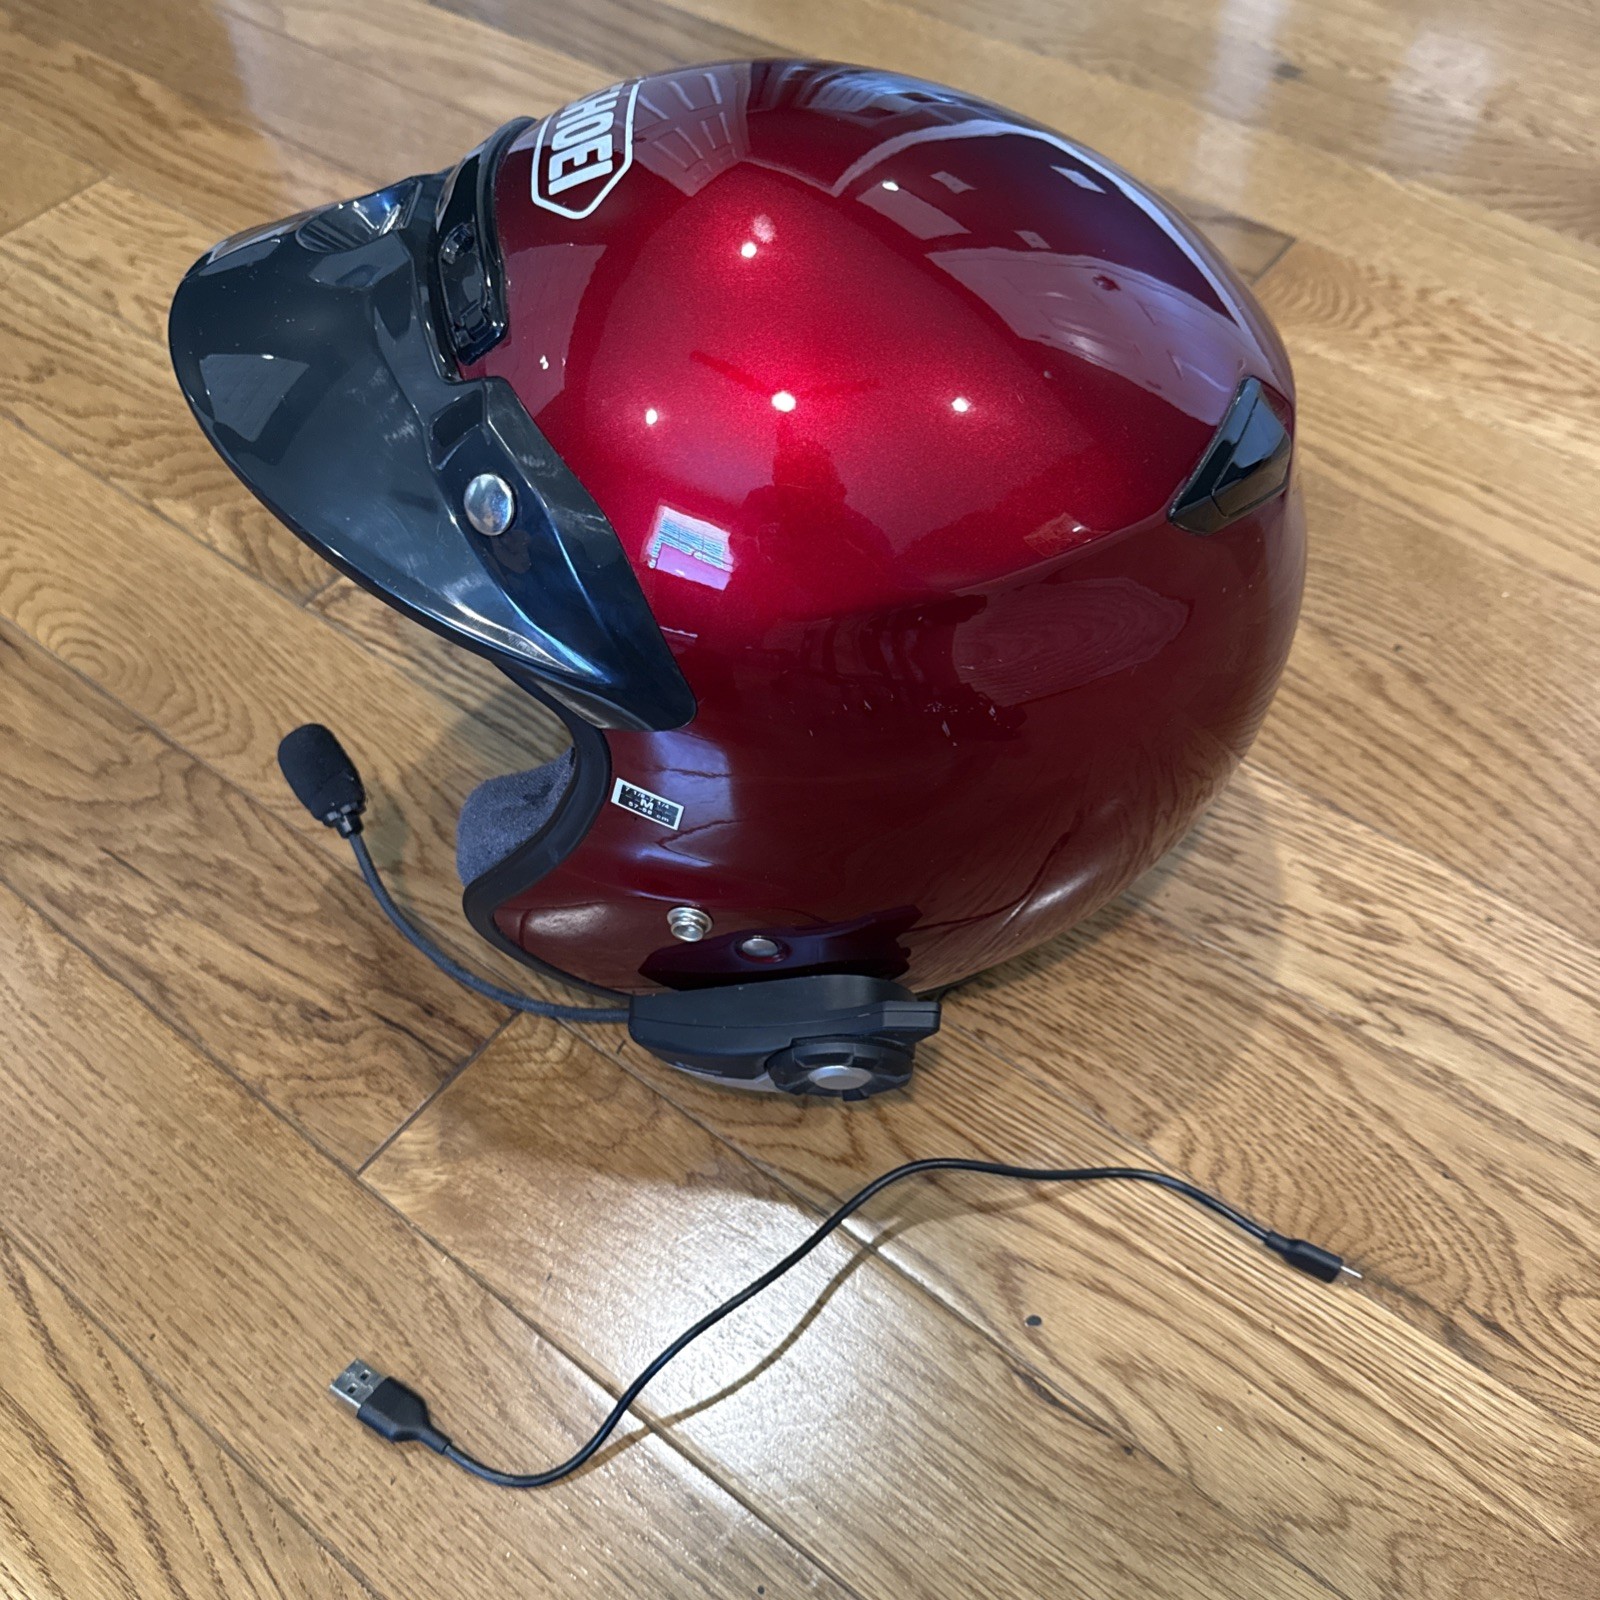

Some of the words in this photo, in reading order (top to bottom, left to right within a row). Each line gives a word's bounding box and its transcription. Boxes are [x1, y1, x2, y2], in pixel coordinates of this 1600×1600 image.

[640, 798, 654, 810] M
[658, 801, 670, 809] 1/4
[656, 814, 669, 822] cm
